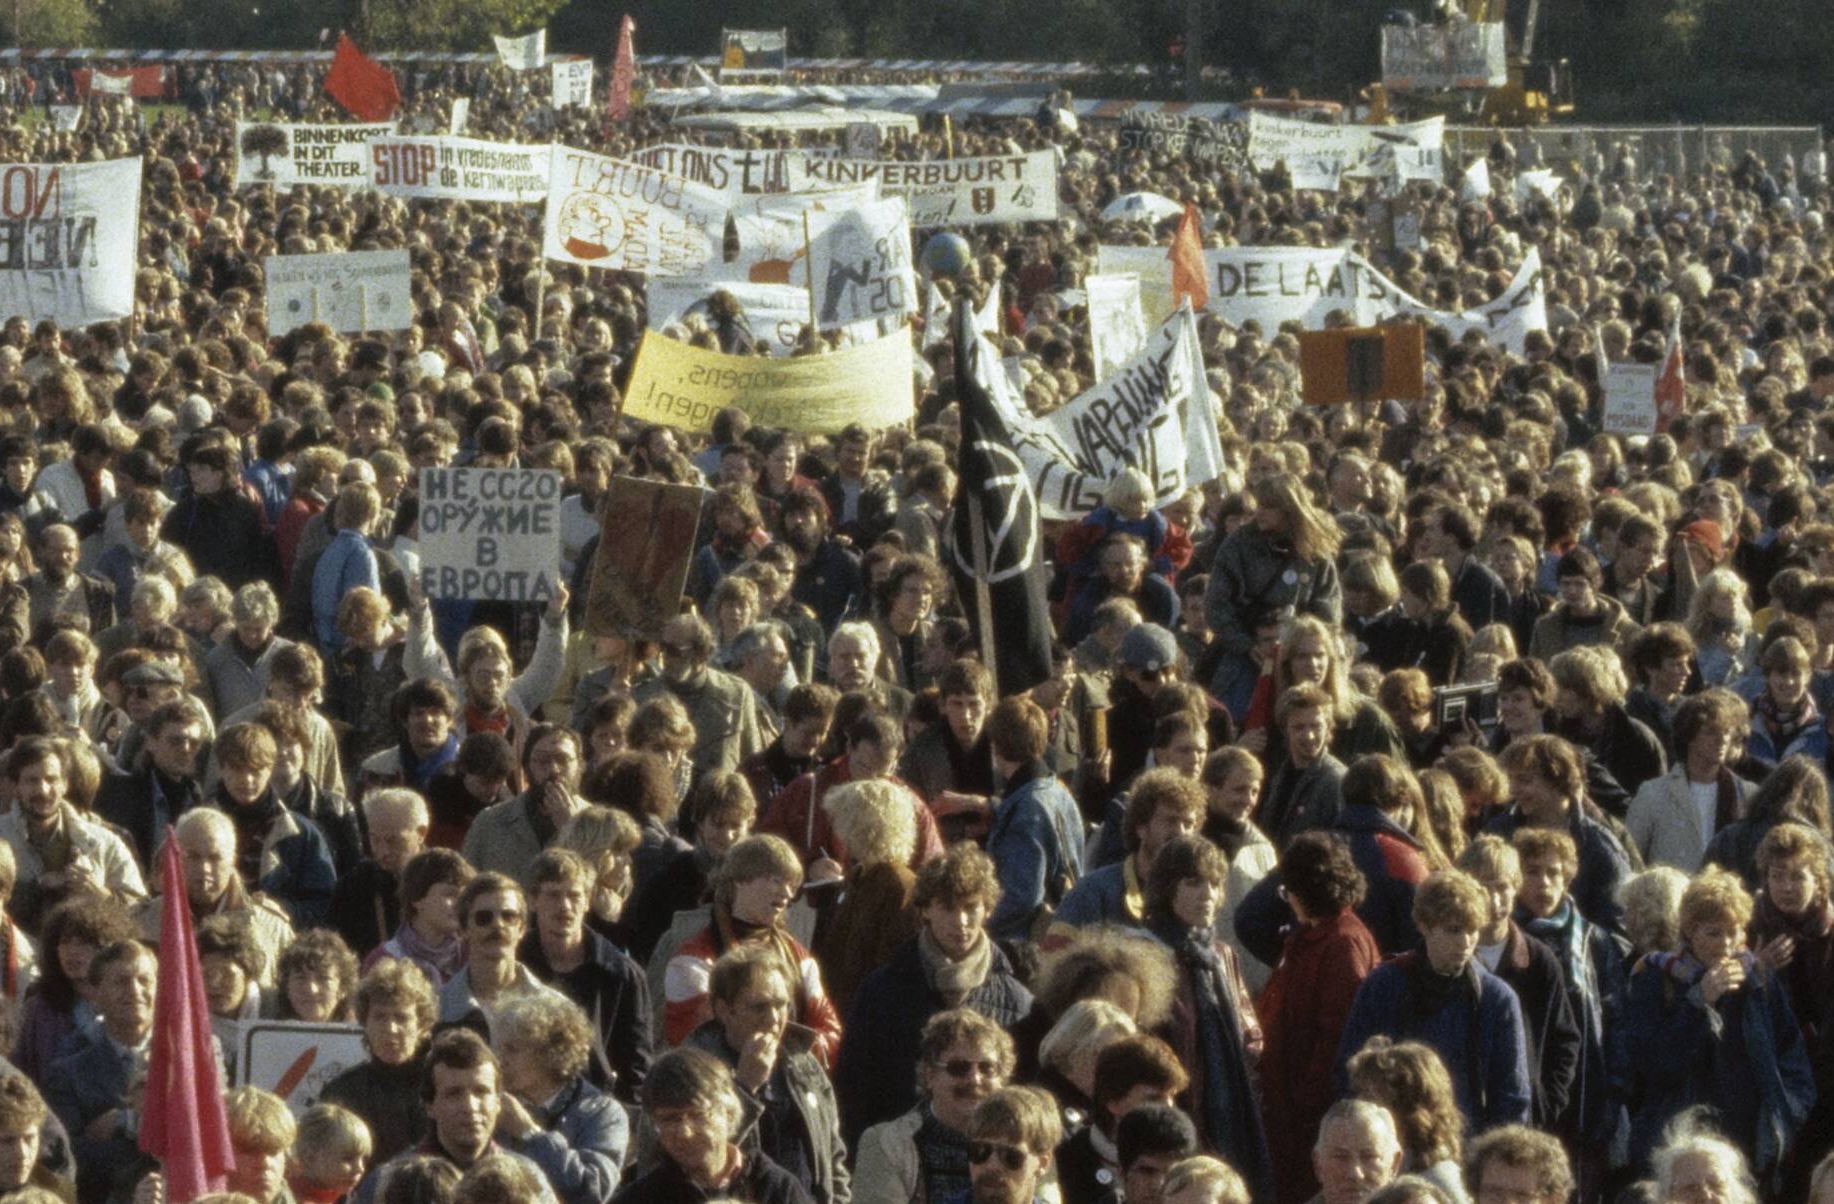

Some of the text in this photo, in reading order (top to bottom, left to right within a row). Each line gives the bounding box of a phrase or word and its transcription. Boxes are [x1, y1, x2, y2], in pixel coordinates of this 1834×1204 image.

[294, 145, 336, 160] IN DIT
[372, 143, 437, 186] STOP
[440, 141, 454, 163] in
[440, 167, 458, 187] de
[805, 157, 1028, 185] KINKERBUURT
[1216, 261, 1268, 298] DE
[476, 536, 499, 567] В
[421, 566, 555, 601] ЕВРОПА
